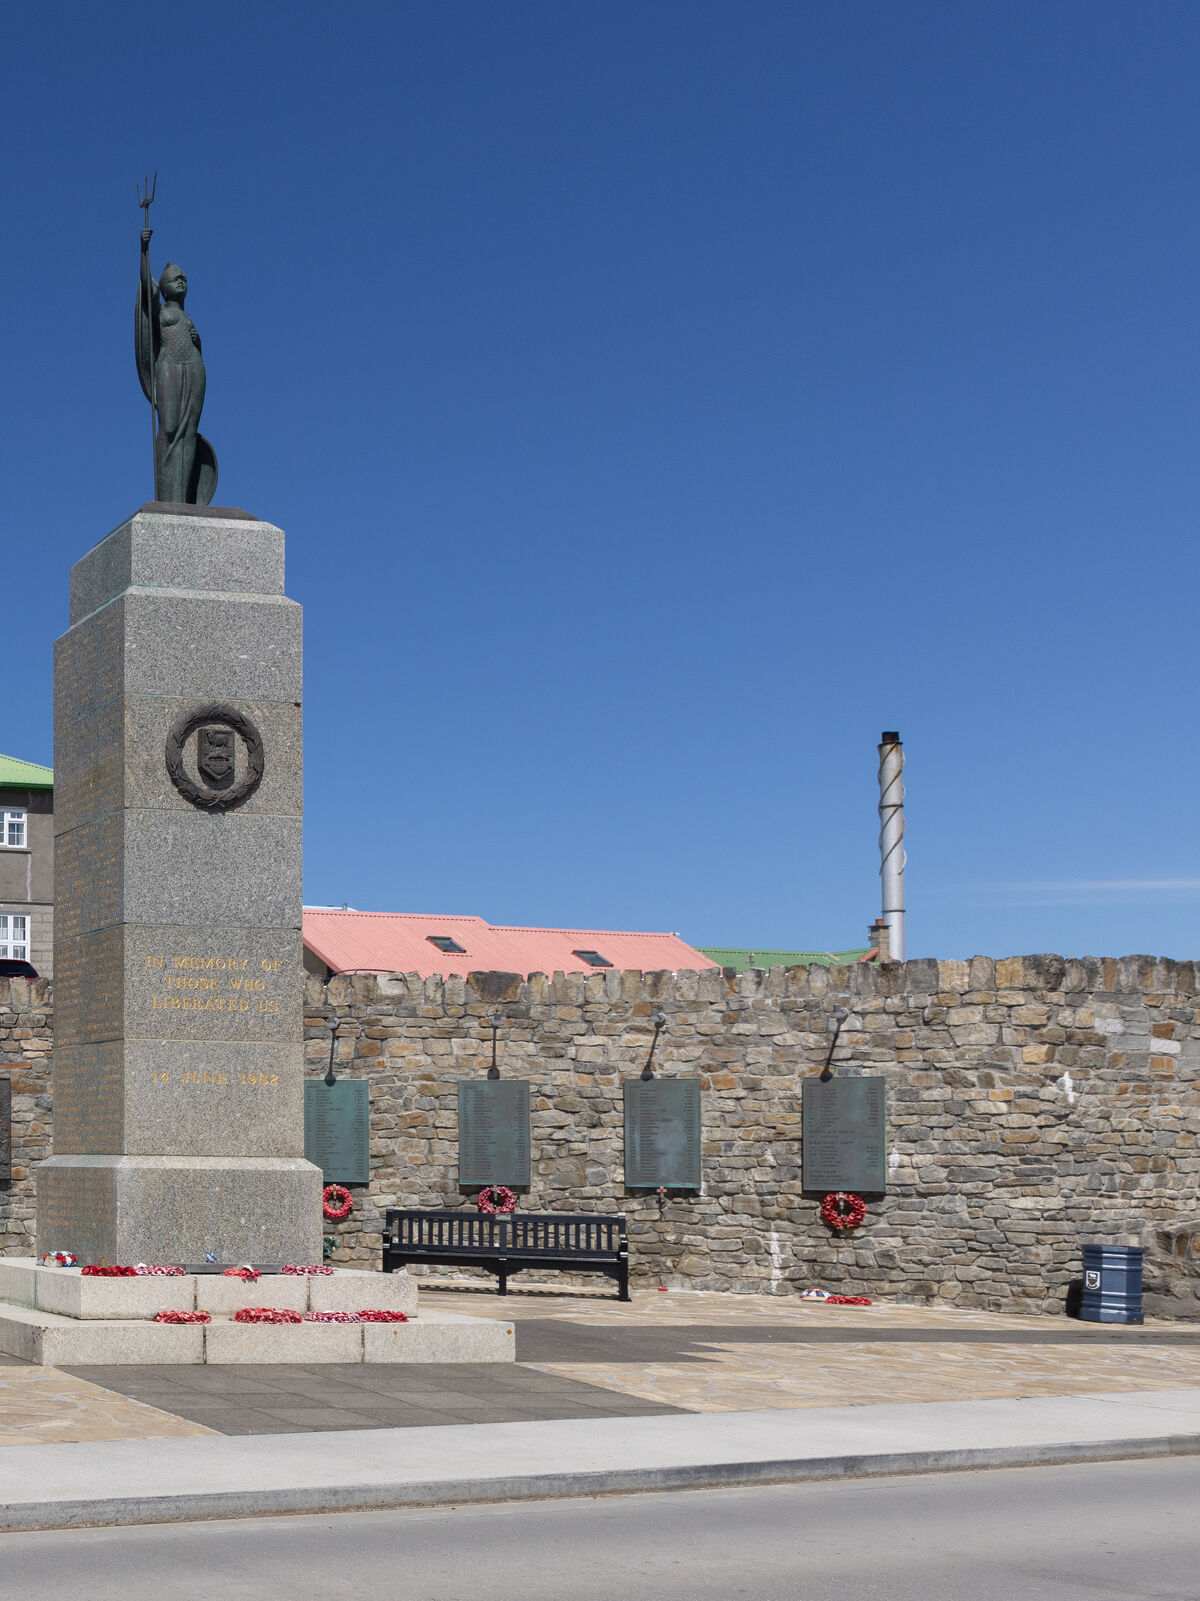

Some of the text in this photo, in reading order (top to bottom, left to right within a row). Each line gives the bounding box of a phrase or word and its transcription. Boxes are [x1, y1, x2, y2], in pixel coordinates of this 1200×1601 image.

[146, 955, 283, 973] IN MEMORY OF
[164, 976, 265, 991] THOSE WHO
[152, 996, 279, 1013] LIBERATED US
[152, 1071, 279, 1086] 14 JUNE 1982
